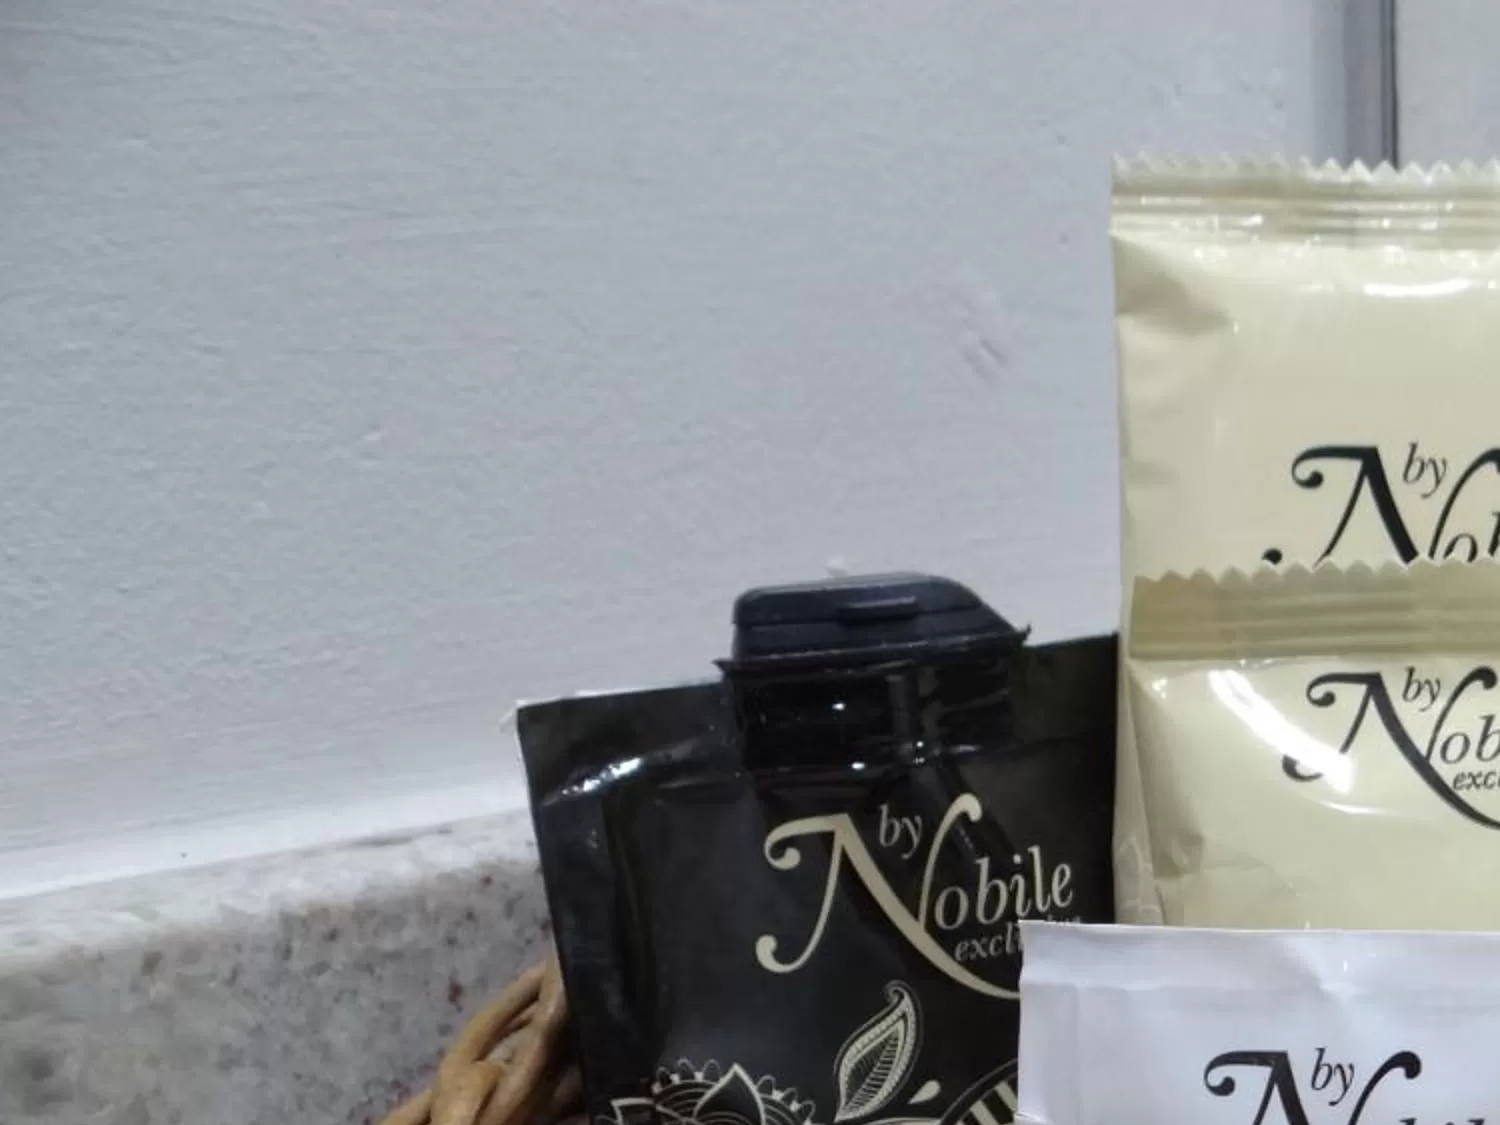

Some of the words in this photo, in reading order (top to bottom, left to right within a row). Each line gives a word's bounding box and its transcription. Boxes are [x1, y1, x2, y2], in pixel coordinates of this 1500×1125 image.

[1402, 442, 1448, 499] by
[1401, 666, 1442, 712] by
[879, 803, 923, 859] by
[755, 793, 1073, 999] Nobile
[954, 921, 1020, 962] excl
[1310, 1047, 1355, 1107] by
